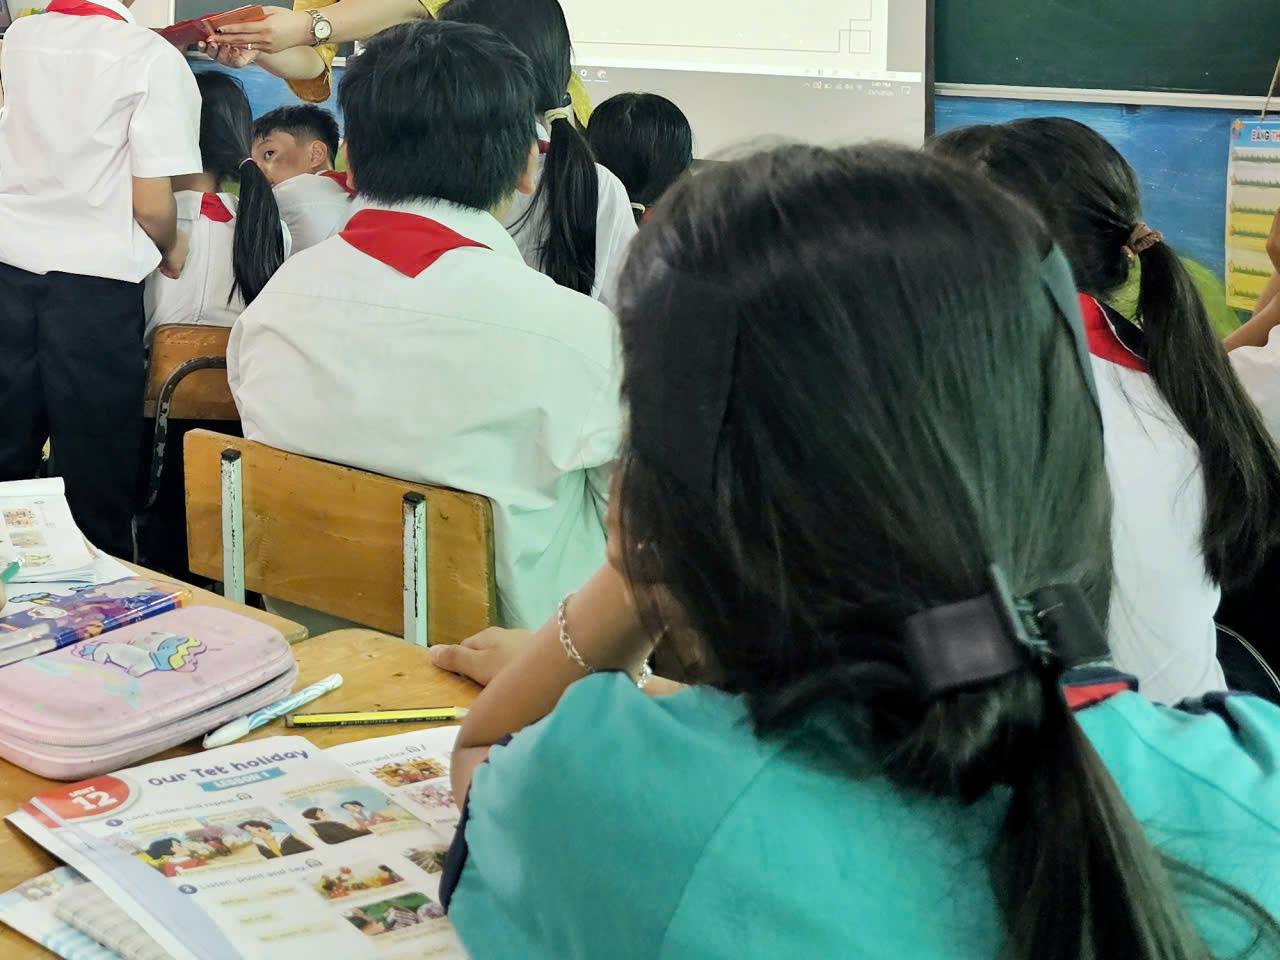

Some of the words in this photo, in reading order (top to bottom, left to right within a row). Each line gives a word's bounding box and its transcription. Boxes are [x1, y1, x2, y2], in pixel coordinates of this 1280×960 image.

[148, 772, 186, 787] Our
[190, 766, 228, 781] Tet
[230, 749, 309, 771] holiday
[72, 790, 118, 811] 12
